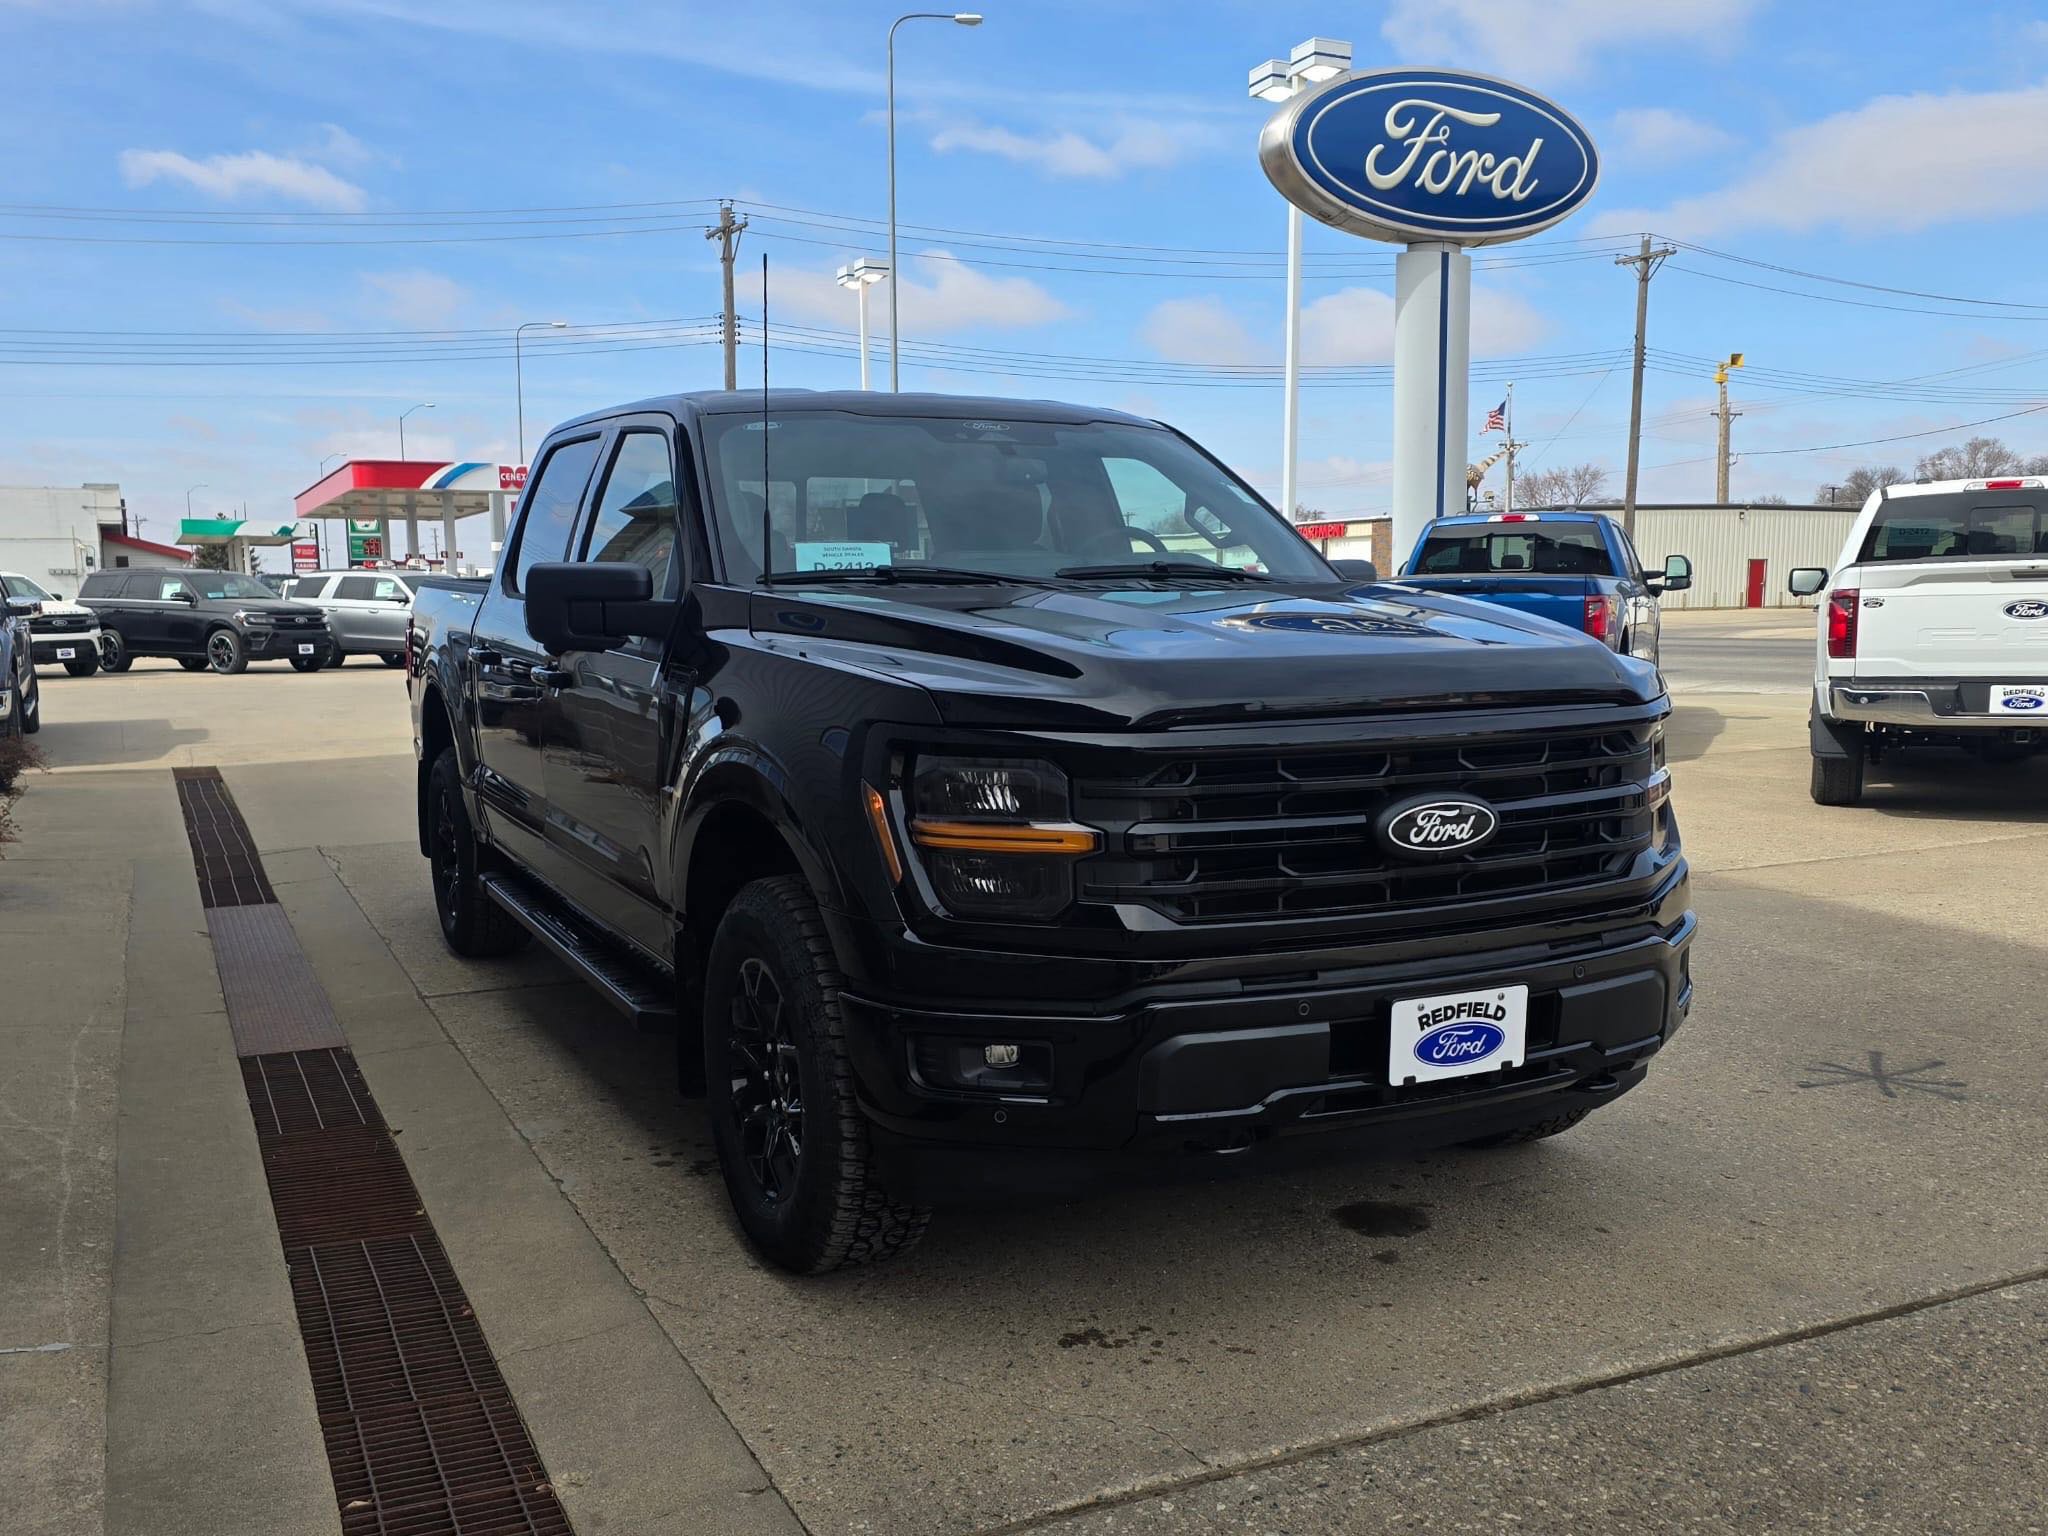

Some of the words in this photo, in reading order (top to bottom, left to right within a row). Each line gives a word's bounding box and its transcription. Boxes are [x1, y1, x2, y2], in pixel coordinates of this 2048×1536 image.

[1365, 98, 1545, 202] Ford
[500, 472, 527, 481] CENEX
[2011, 602, 2045, 616] Ford
[2003, 689, 2045, 697] REDFIELD
[2009, 698, 2036, 708] Ford
[1410, 808, 1476, 844] Ford
[1418, 1001, 1507, 1032] REDFIELD
[1433, 1029, 1486, 1059] Ford
